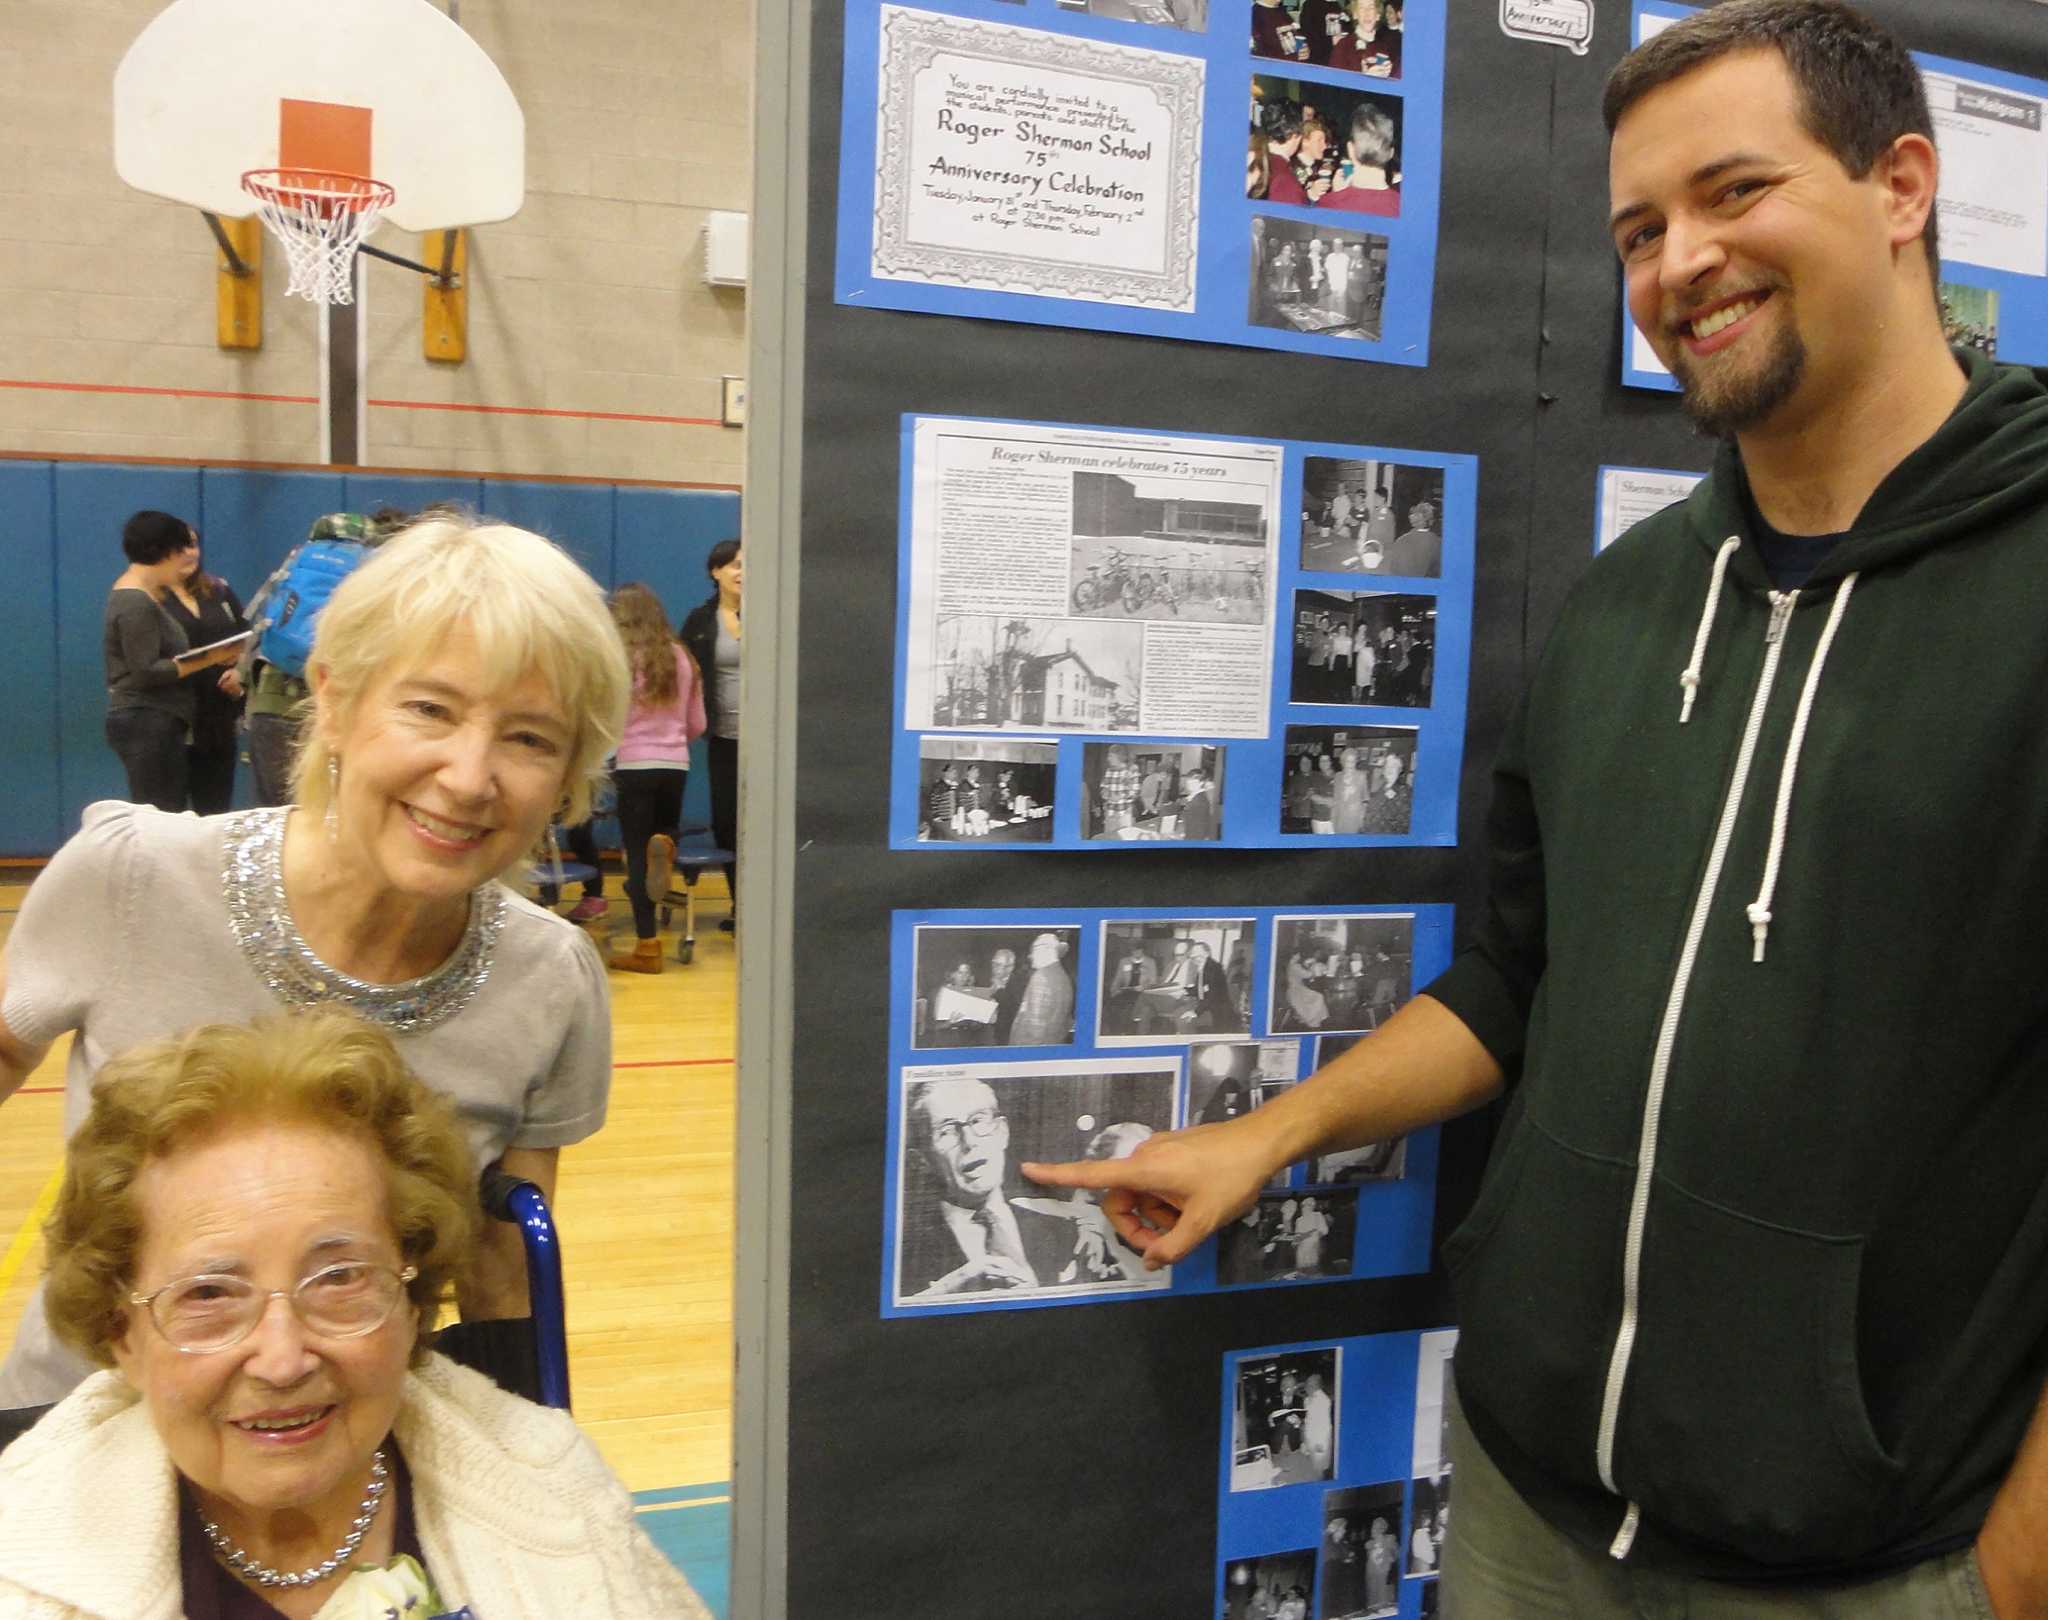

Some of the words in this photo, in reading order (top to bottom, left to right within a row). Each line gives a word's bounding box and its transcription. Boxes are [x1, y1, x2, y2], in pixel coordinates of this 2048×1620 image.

[949, 73, 970, 90] You
[975, 84, 995, 93] are
[1002, 84, 1049, 109] cordially
[1056, 95, 1089, 107] invited
[1096, 100, 1107, 110] to
[937, 108, 1005, 145] Roger
[1016, 120, 1093, 152] Sherman
[1099, 133, 1152, 161] School
[928, 155, 1043, 196] Anniversary
[1049, 170, 1145, 202] Celebration
[990, 212, 1018, 230] Roger
[1022, 217, 1063, 232] Sherman
[1068, 222, 1101, 237] School
[991, 446, 1036, 463] Roger
[1037, 449, 1099, 467] Sherman
[1101, 456, 1169, 473] celebrates
[1173, 461, 1190, 475] 75
[1190, 465, 1228, 480] years
